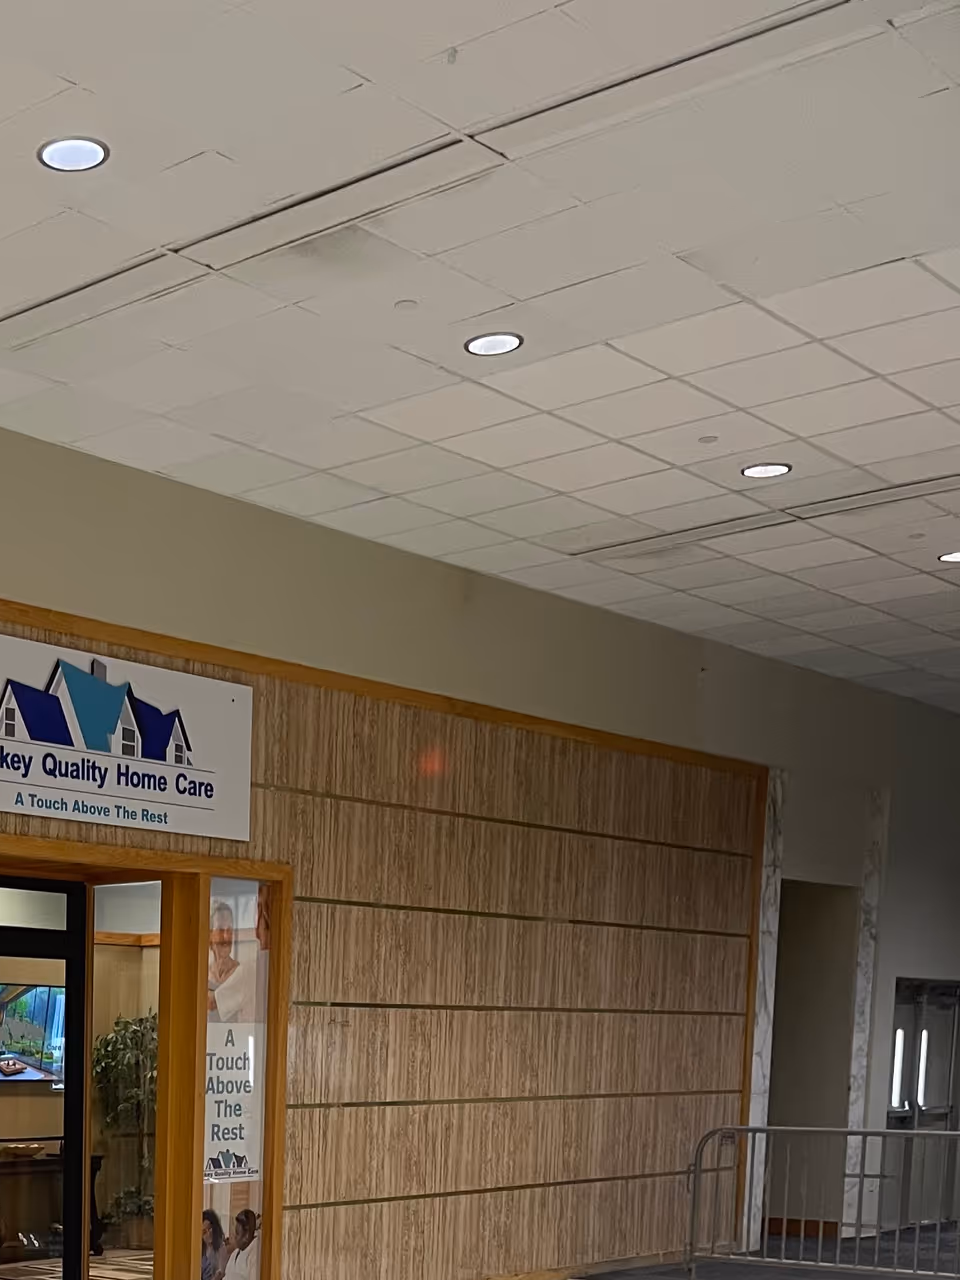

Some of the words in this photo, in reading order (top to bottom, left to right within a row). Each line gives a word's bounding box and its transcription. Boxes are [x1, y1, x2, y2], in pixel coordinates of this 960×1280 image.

[41, 752, 108, 789] Quality
[116, 763, 168, 792] Home
[175, 772, 214, 799] Care
[14, 791, 25, 806] A
[28, 793, 68, 812] Touch
[71, 799, 110, 817] Above
[114, 804, 137, 820] The
[141, 808, 168, 825] Rest
[224, 1029, 235, 1047] A
[206, 1051, 250, 1071] Touch
[205, 1076, 252, 1095] Above
[214, 1100, 242, 1118] The
[211, 1123, 245, 1142] Rest
